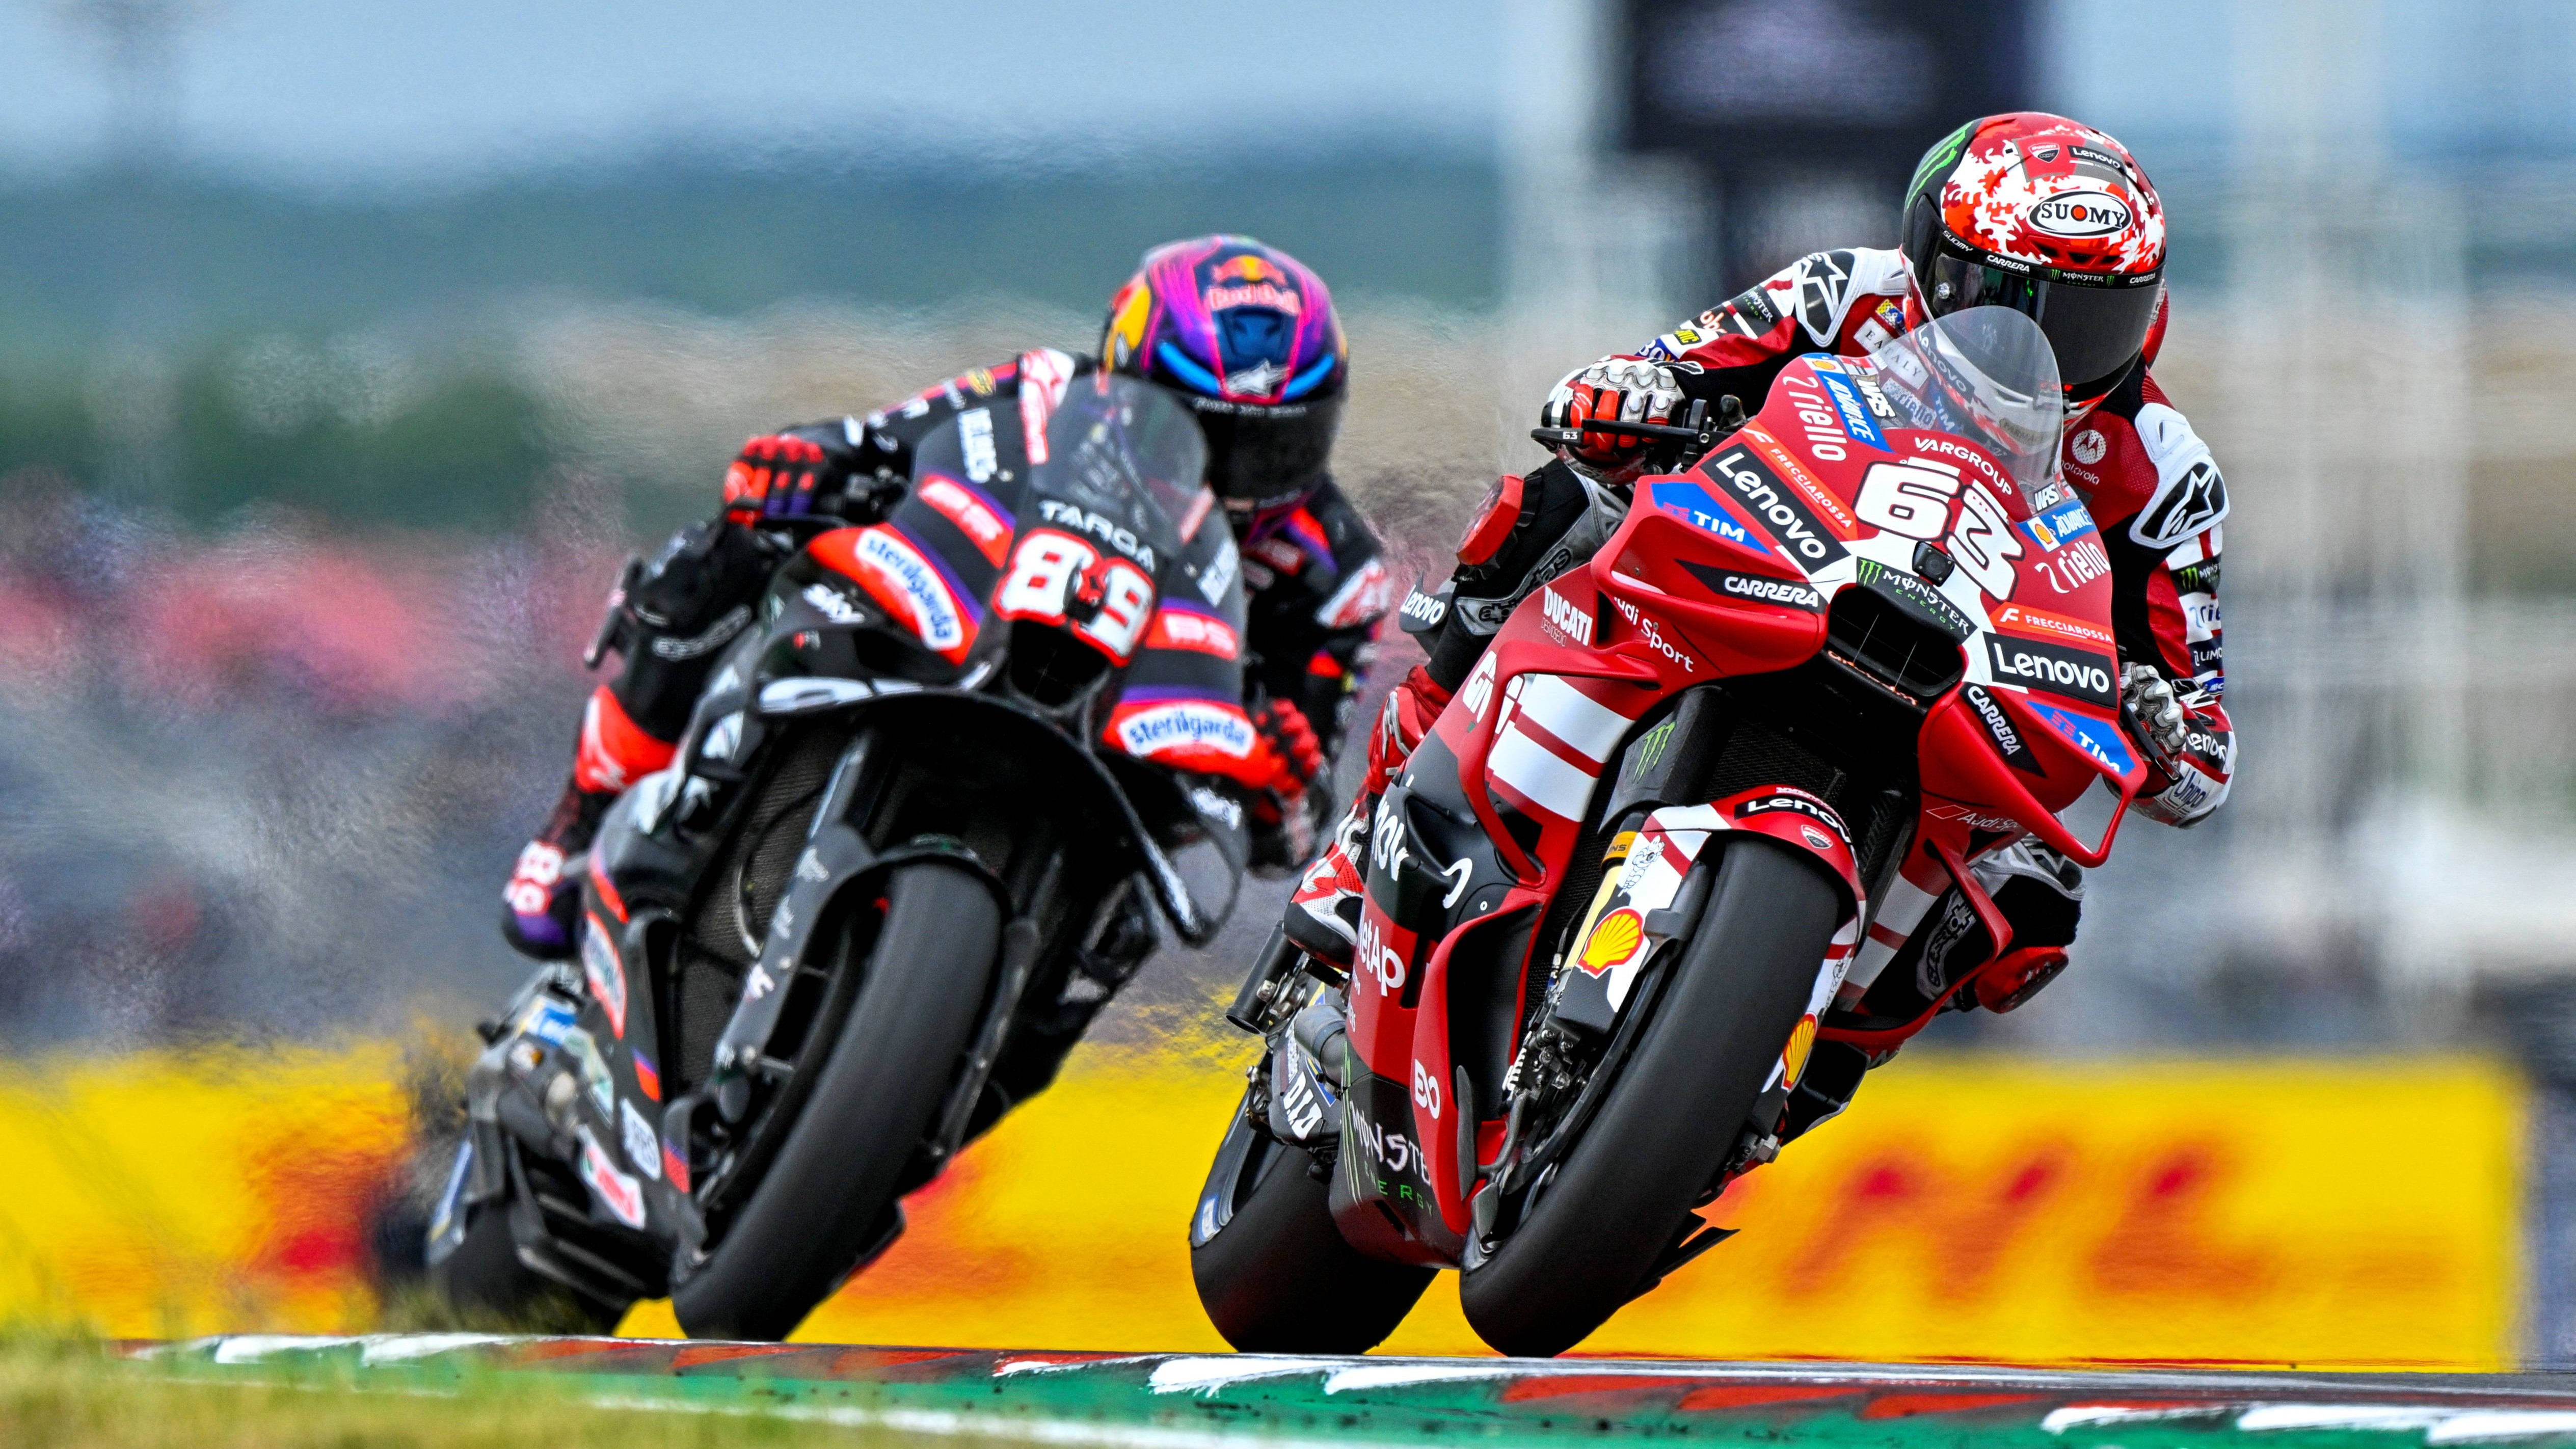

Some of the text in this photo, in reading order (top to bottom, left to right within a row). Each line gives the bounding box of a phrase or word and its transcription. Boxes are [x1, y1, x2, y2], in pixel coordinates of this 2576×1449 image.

[2073, 147, 2121, 169] Lenovo
[2040, 202, 2125, 228] SUOMY
[1943, 230, 1974, 252] SUOMY
[1987, 255, 2030, 272] CARRERA
[1822, 375, 1876, 442] ADVANCE
[1856, 379, 1896, 418] WRS
[1563, 431, 1578, 440] 63
[1788, 391, 1847, 462] riello
[1914, 436, 2013, 496] VARGROUP
[1715, 451, 1827, 559] Lenovo
[1769, 448, 1852, 529] FRECCIAROSSA
[2034, 484, 2059, 511] WRS
[1694, 510, 1745, 542] TIM
[1855, 459, 2025, 603] 63
[2057, 540, 2112, 588] riello
[996, 530, 1157, 662] 89
[1400, 584, 1446, 625] Lenovo
[1724, 576, 1819, 608] CARRERA
[1883, 569, 1970, 636] MONSTER
[1895, 588, 1956, 631] ENERGY
[1543, 585, 1594, 646] DUCATI
[2025, 614, 2114, 643] FRECCIAROSSA
[1641, 618, 1695, 673] Sport
[1994, 642, 2110, 693] Lenovo
[1967, 686, 2022, 756] CARRERA
[2079, 731, 2121, 773] TIM
[1804, 826, 1832, 844] DUCATI
[1957, 813, 2000, 828] Audi
